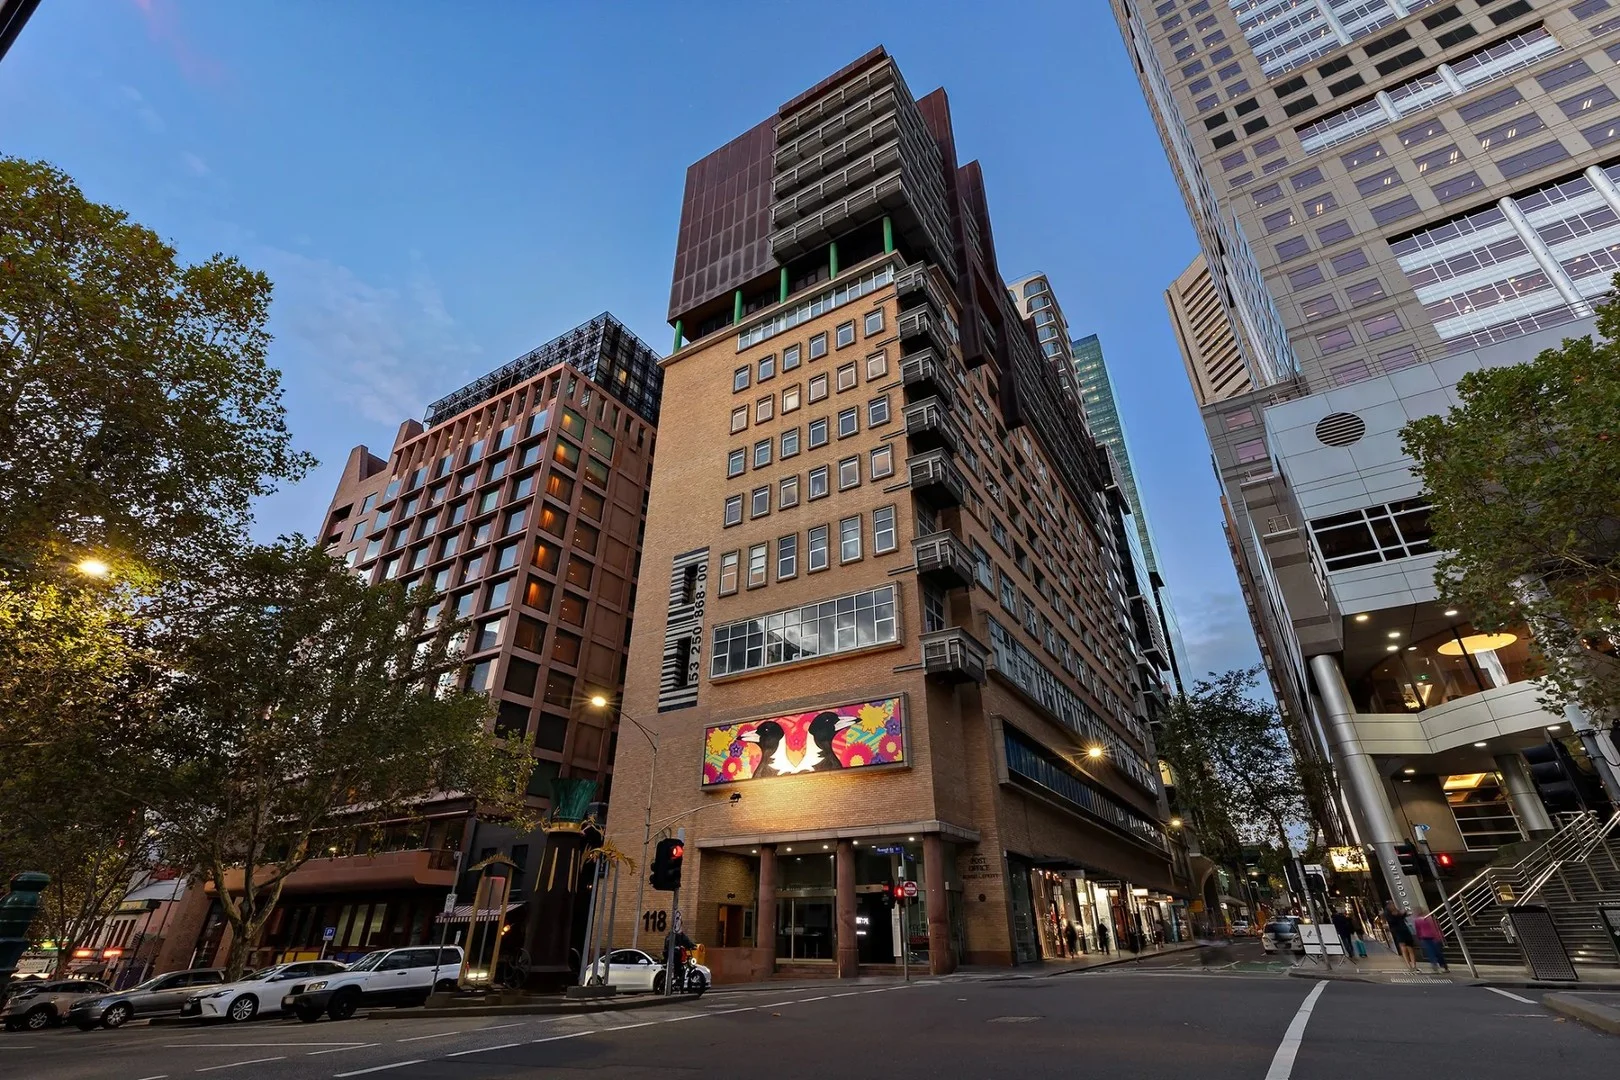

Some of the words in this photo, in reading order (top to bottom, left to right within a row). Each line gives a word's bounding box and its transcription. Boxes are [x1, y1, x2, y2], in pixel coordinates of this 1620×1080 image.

[691, 626, 703, 655] 250
[689, 661, 699, 681] 53
[1387, 859, 1406, 897] COLLINS
[642, 910, 667, 932] 118
